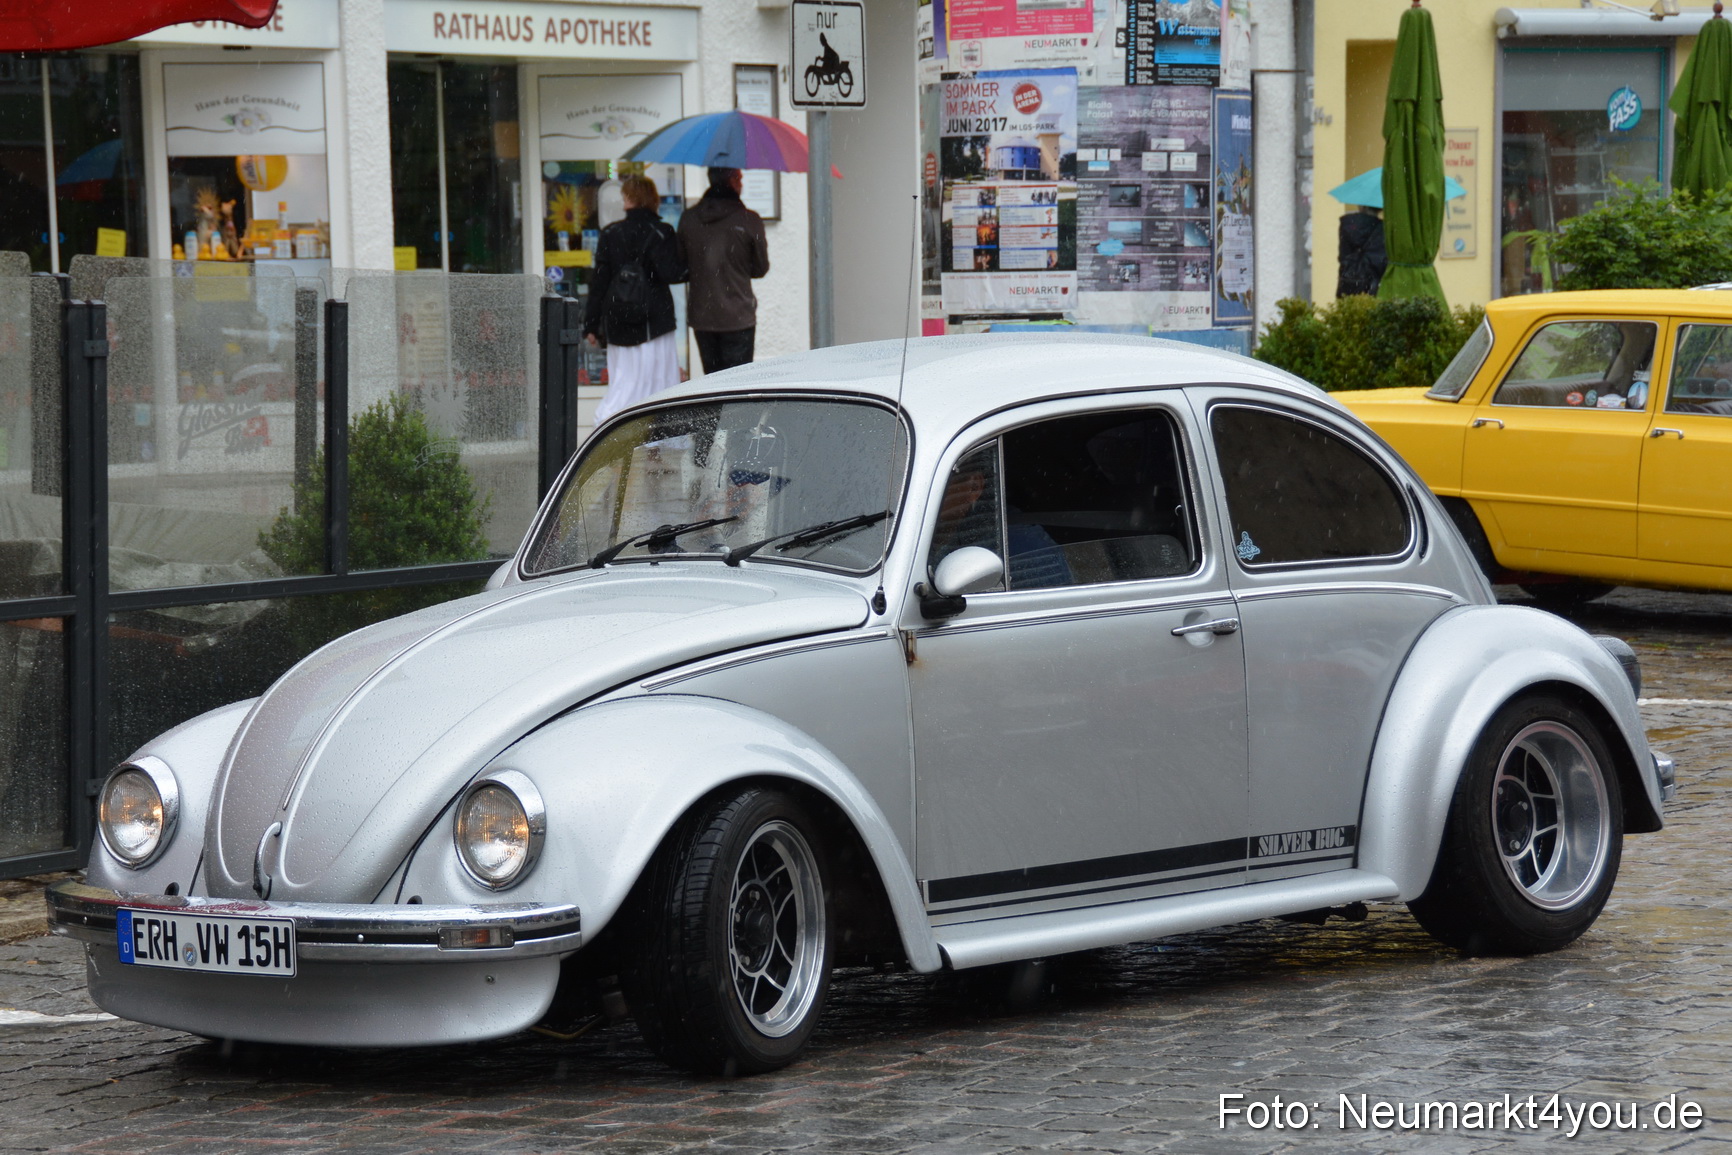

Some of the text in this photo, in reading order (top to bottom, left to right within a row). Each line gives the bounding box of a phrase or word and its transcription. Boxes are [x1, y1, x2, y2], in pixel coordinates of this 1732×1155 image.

[816, 10, 838, 29] nur
[433, 12, 652, 46] RATHAUS APOTHEKE
[1024, 38, 1078, 48] NEUMARKT
[945, 82, 1000, 99] SOMMER
[195, 94, 301, 112] Haus der Gesundheit
[608, 103, 662, 120] Gesundheit
[946, 100, 997, 116] IM PARK
[1609, 94, 1637, 132] FASS
[975, 117, 1008, 132] 2017
[1009, 286, 1059, 295] NEUMARKT
[1163, 306, 1204, 315] NEUMARKT
[1258, 827, 1345, 856] SILVER BUG
[123, 942, 130, 953] D
[133, 918, 292, 968] ERH VW 15H
